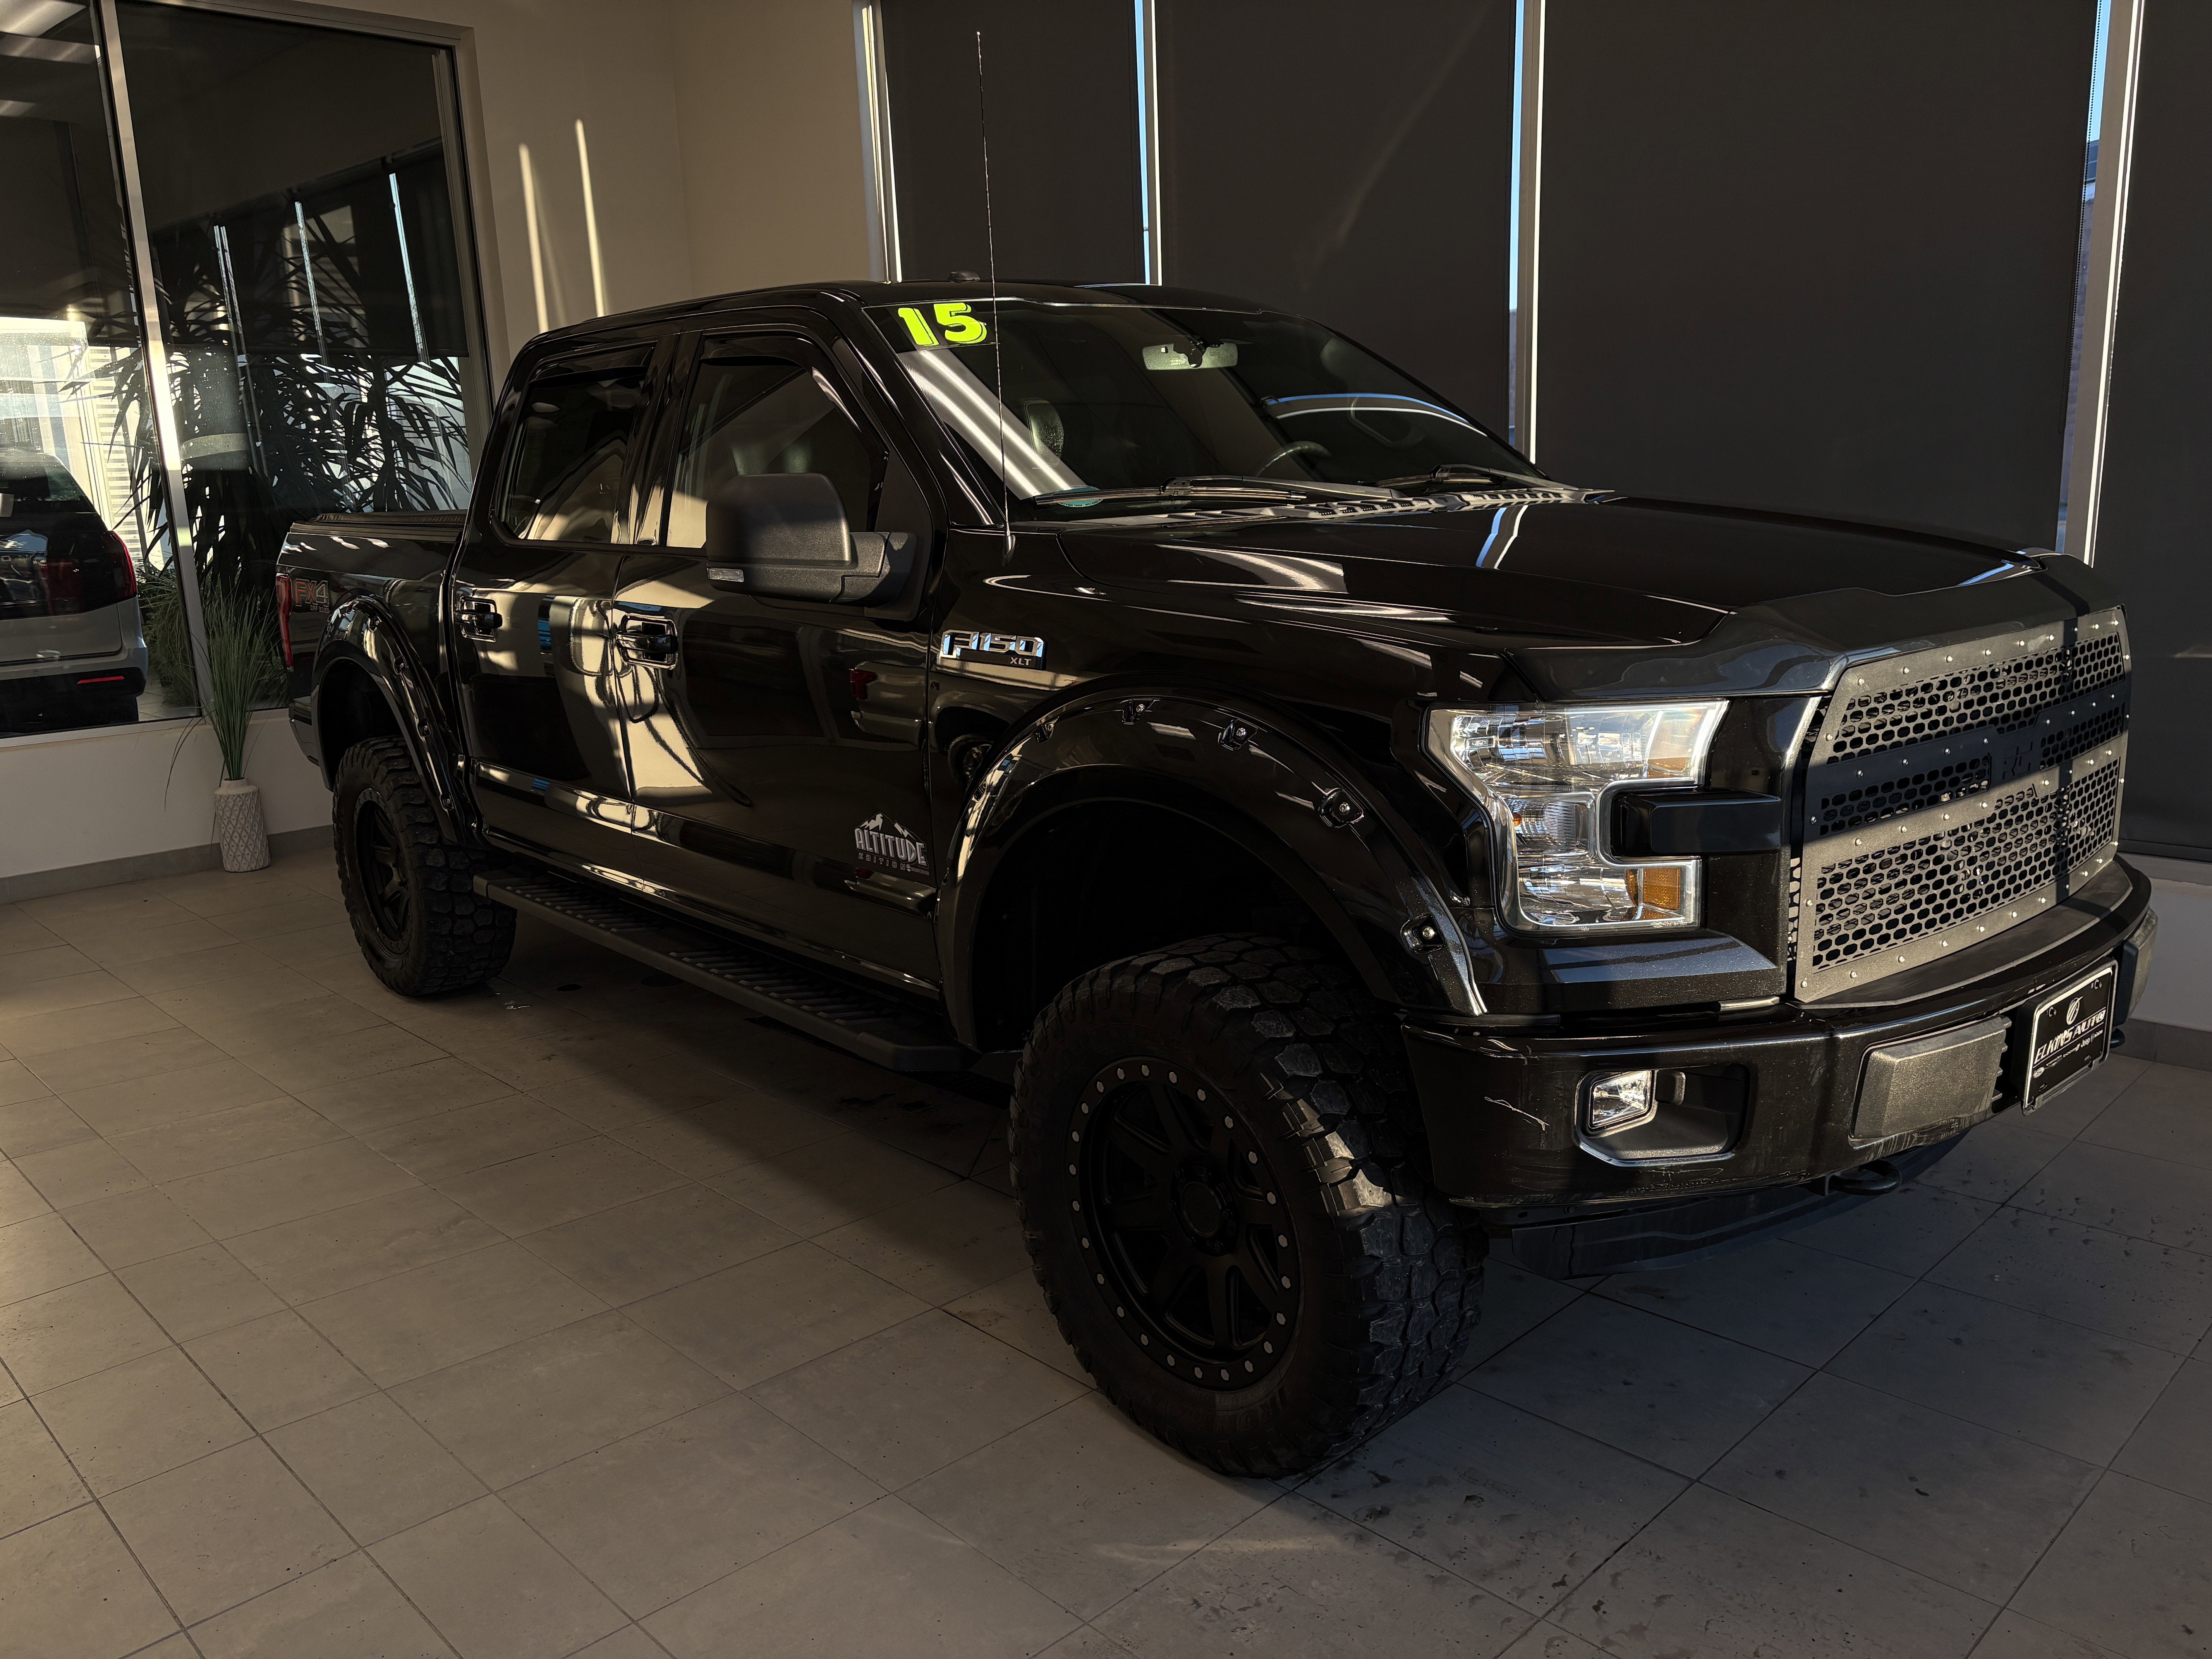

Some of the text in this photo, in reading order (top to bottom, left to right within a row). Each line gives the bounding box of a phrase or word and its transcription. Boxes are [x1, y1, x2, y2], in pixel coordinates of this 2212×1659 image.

[898, 302, 987, 346] 15
[294, 578, 329, 607] FX4
[1010, 657, 1032, 666] XLT
[855, 828, 927, 866] ALTITUDE
[859, 852, 905, 871] EDITION
[2034, 1009, 2106, 1064] ELKINS AUTO
